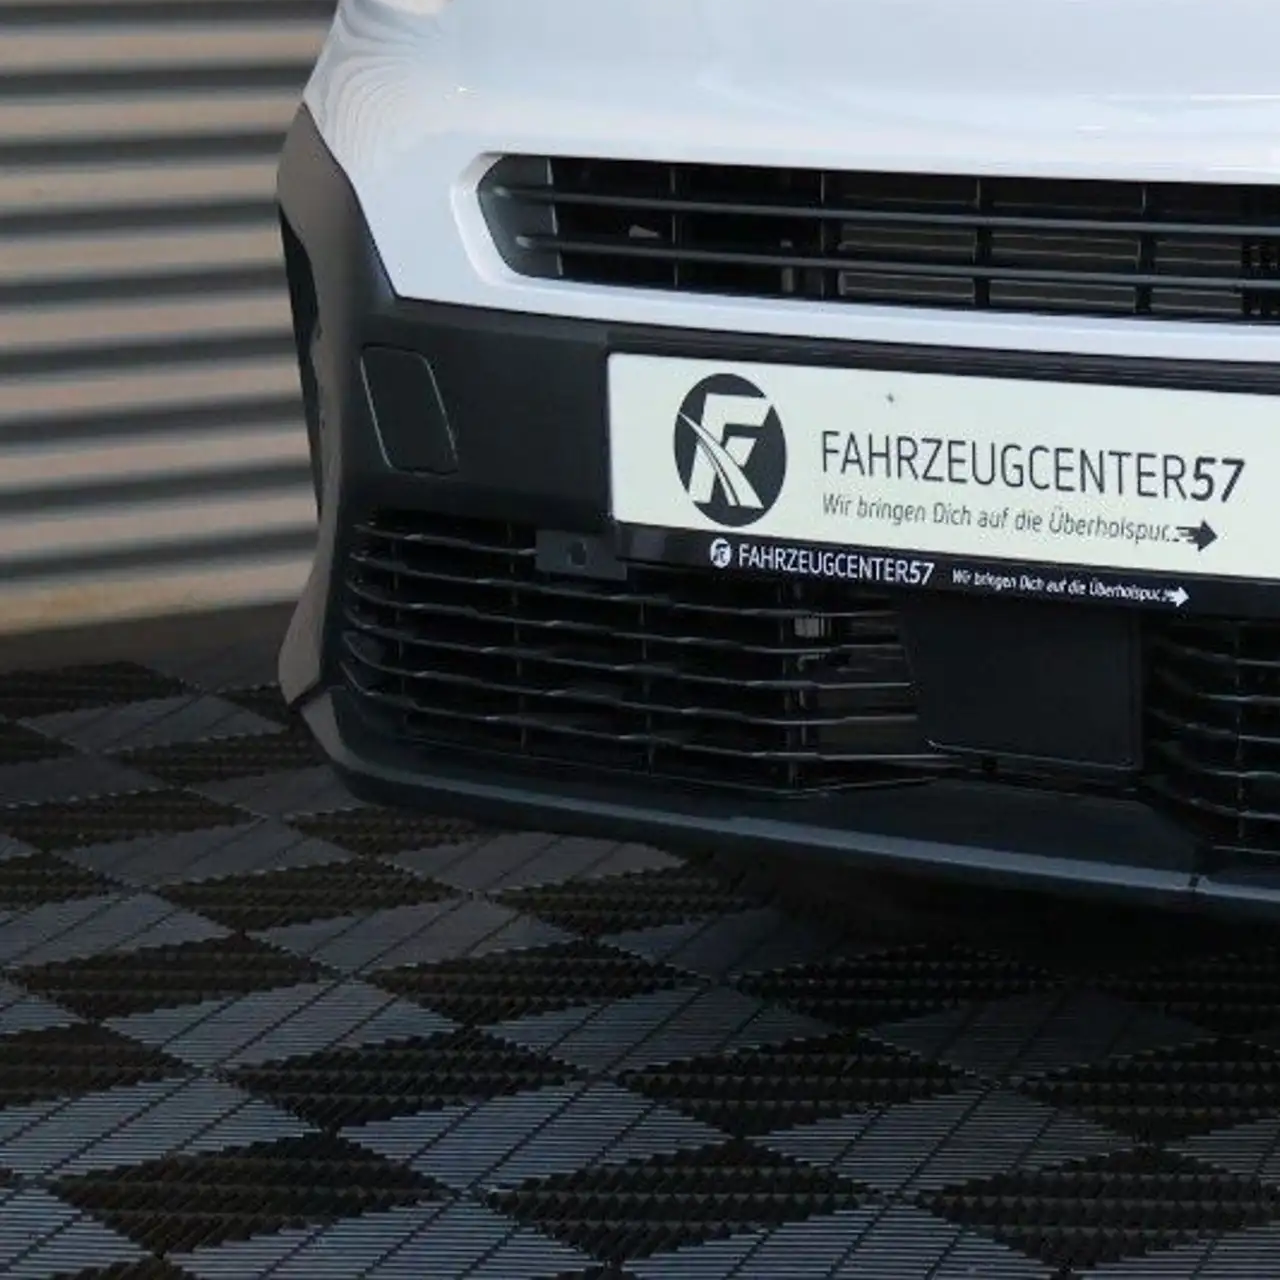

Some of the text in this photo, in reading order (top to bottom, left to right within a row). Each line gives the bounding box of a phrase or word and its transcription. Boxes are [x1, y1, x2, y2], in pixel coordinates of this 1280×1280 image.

[821, 430, 1246, 503] FAHRZEUGCENTER57
[822, 492, 852, 517] Wir
[857, 494, 926, 526] bringen
[933, 502, 972, 527] Dich
[977, 507, 1010, 529] auf
[1014, 510, 1043, 533] die
[738, 543, 935, 586] FAHRZEUGCENTER57
